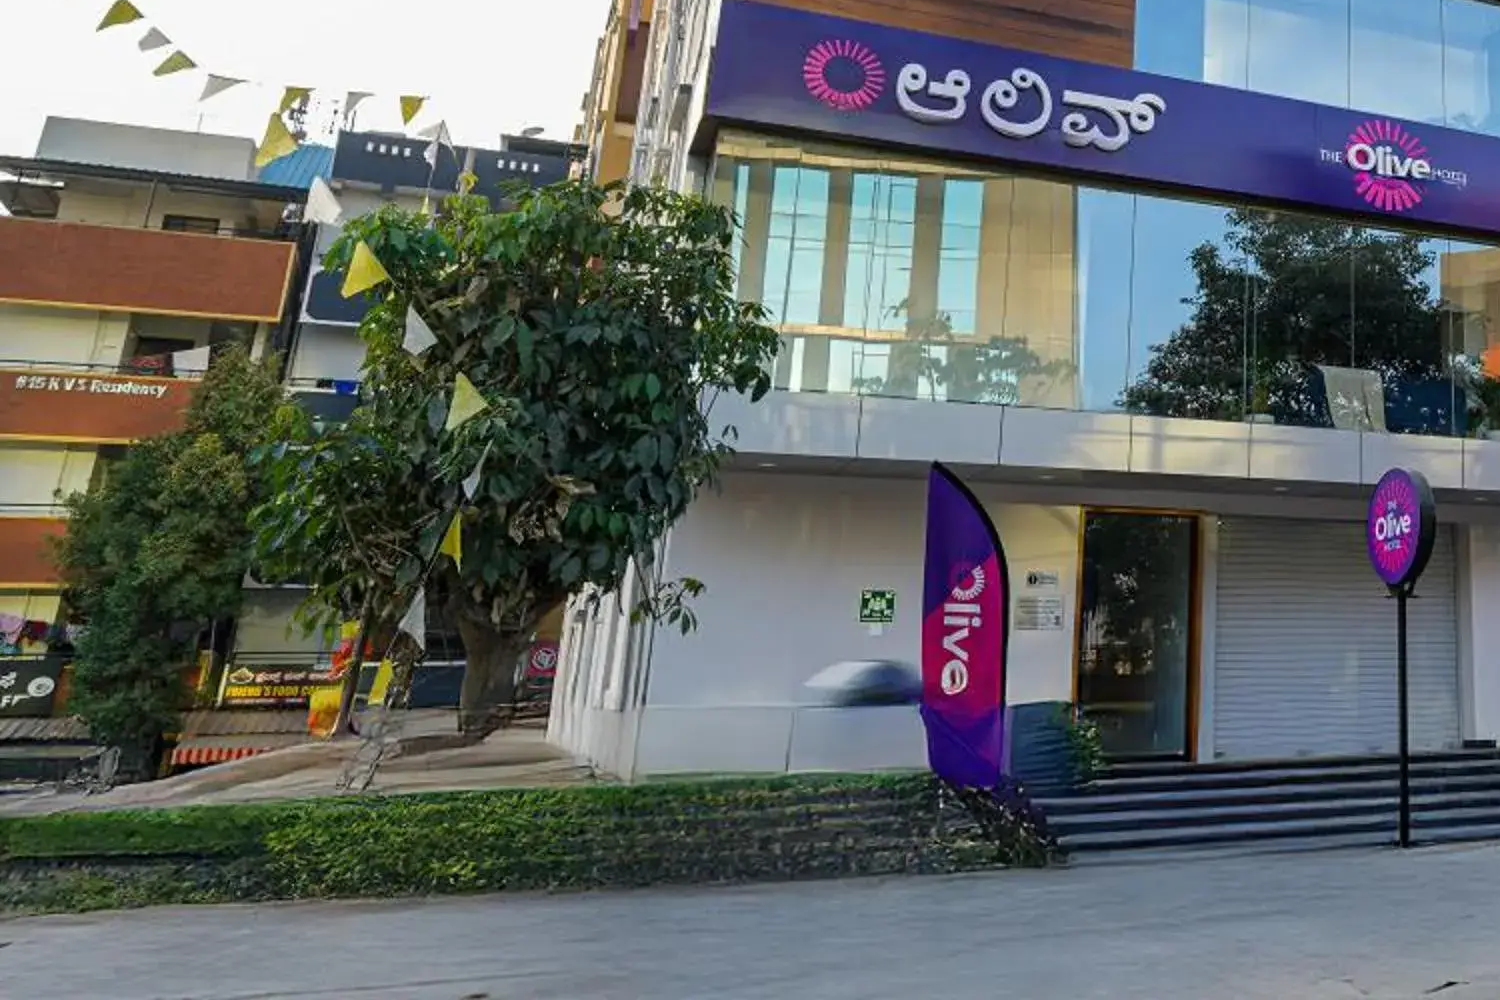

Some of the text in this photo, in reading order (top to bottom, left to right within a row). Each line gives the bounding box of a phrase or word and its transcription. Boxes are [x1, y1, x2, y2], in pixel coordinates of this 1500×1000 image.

[895, 62, 1168, 152] ಆಲಿವ್
[1319, 148, 1345, 164] THE
[1348, 143, 1431, 179] Olive
[89, 379, 169, 399] Residency
[1375, 513, 1411, 541] Olive
